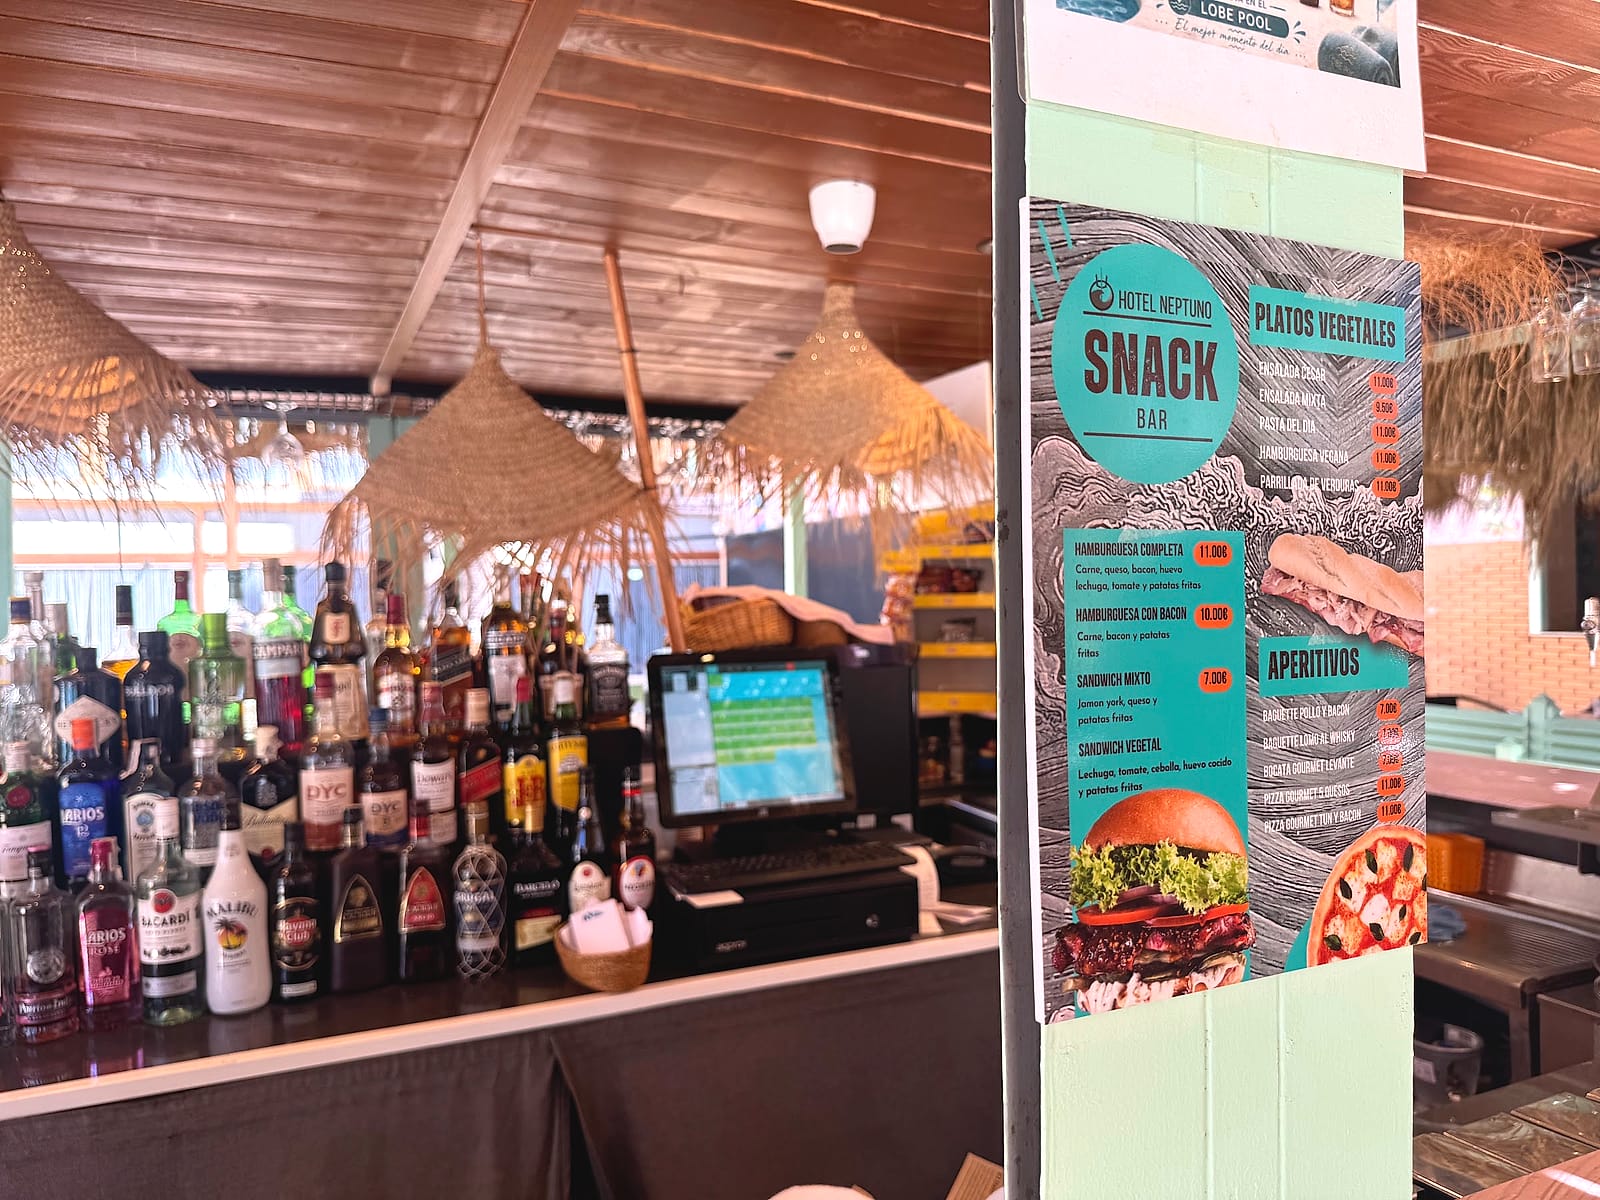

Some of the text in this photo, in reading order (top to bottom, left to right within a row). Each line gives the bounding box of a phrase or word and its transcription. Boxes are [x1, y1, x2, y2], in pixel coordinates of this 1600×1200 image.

[1258, 0, 1267, 9] EL
[1201, 1, 1272, 31] LOBE POOL
[1175, 18, 1188, 31] El
[1191, 26, 1216, 38] mejor
[1220, 33, 1257, 47] momento
[1260, 39, 1272, 52] del
[1119, 290, 1212, 319] HOTEL NEPTUNO
[1255, 302, 1396, 348] PLATOS VEGETALES
[1084, 329, 1219, 401] SNACK
[1259, 361, 1300, 378] ENSALADA
[1259, 389, 1300, 405] ENSALADA
[1301, 393, 1326, 409] MIXTA
[1137, 408, 1167, 430] BAR
[1259, 416, 1286, 433] PASTA
[1287, 418, 1302, 433] DEL
[1259, 445, 1318, 462] HAMBURGUESA
[1319, 450, 1349, 464] VEGANA
[1260, 474, 1308, 491] PARRILLADA
[1321, 478, 1360, 493] VERDURAS
[1075, 542, 1227, 558] HAMBURGUESA COMPLETA 11.00€
[1075, 564, 1183, 576] Carne, queso, bacon, huevo
[1075, 580, 1202, 592] lechuga, tomate y patatas fritas
[1075, 606, 1228, 622] HAMBURGUESA CON BACON 10.00€
[1077, 630, 1170, 642] Carne, bacon y patatas
[1077, 648, 1100, 658] fritas
[1267, 647, 1360, 681] APERITIVOS
[1077, 671, 1227, 689] SANDWICH MIXTO 7.00€
[1077, 696, 1158, 710] Jamon york, queso y
[1263, 708, 1298, 722] BAGUETTE
[1299, 705, 1320, 719] POLLO
[1321, 705, 1327, 717] Y
[1328, 703, 1350, 717] BACON
[1078, 712, 1133, 727] patatas fritas
[1078, 737, 1162, 757] SANDWICH VEGETAL
[1263, 730, 1356, 750] BAGUETTE LOMO AL WHISKY
[1078, 757, 1232, 780] Lechuga, tomate, cebolla, huevo cocido
[1263, 765, 1291, 778] BOCATA
[1292, 759, 1325, 775] GOURMET
[1325, 756, 1355, 770] LEVANTE
[306, 784, 347, 800] DYC
[1078, 781, 1143, 798] y patatas fritas
[1264, 792, 1284, 805] PIZZA
[1285, 787, 1319, 802] GOURMET
[1324, 784, 1350, 798] QUESOS
[371, 802, 399, 814] DYC
[1264, 820, 1284, 834] PIZZA
[1285, 814, 1319, 830] GOURMET
[1319, 812, 1333, 825] TUN
[1333, 811, 1340, 823] Y
[1340, 808, 1362, 822] BACON
[86, 927, 126, 946] ARIOS
